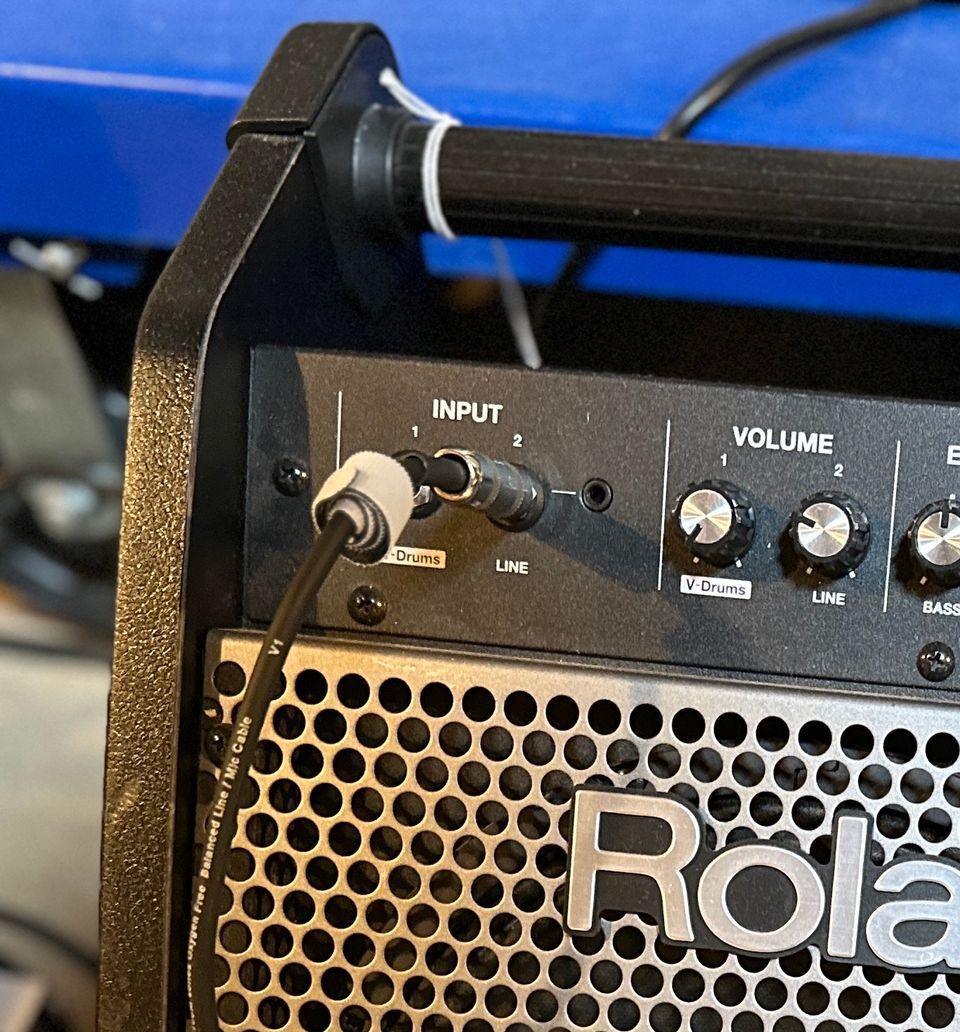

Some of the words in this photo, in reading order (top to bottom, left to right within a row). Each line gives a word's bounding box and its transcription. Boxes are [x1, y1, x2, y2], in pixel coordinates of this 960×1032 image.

[432, 399, 503, 424] INPUT
[411, 425, 419, 438] 1
[512, 434, 523, 447] 2
[733, 426, 834, 455] VOLUME
[719, 453, 728, 467] 1
[834, 463, 844, 477] 2
[384, 548, 441, 565] -Drums
[496, 559, 529, 576] LINE
[685, 579, 747, 597] V-Drums
[812, 590, 846, 606] LINE
[231, 716, 252, 754] Cable
[224, 757, 240, 780] Mic
[212, 790, 229, 818] Line
[200, 819, 221, 879] Balanced
[193, 884, 207, 914] Free
